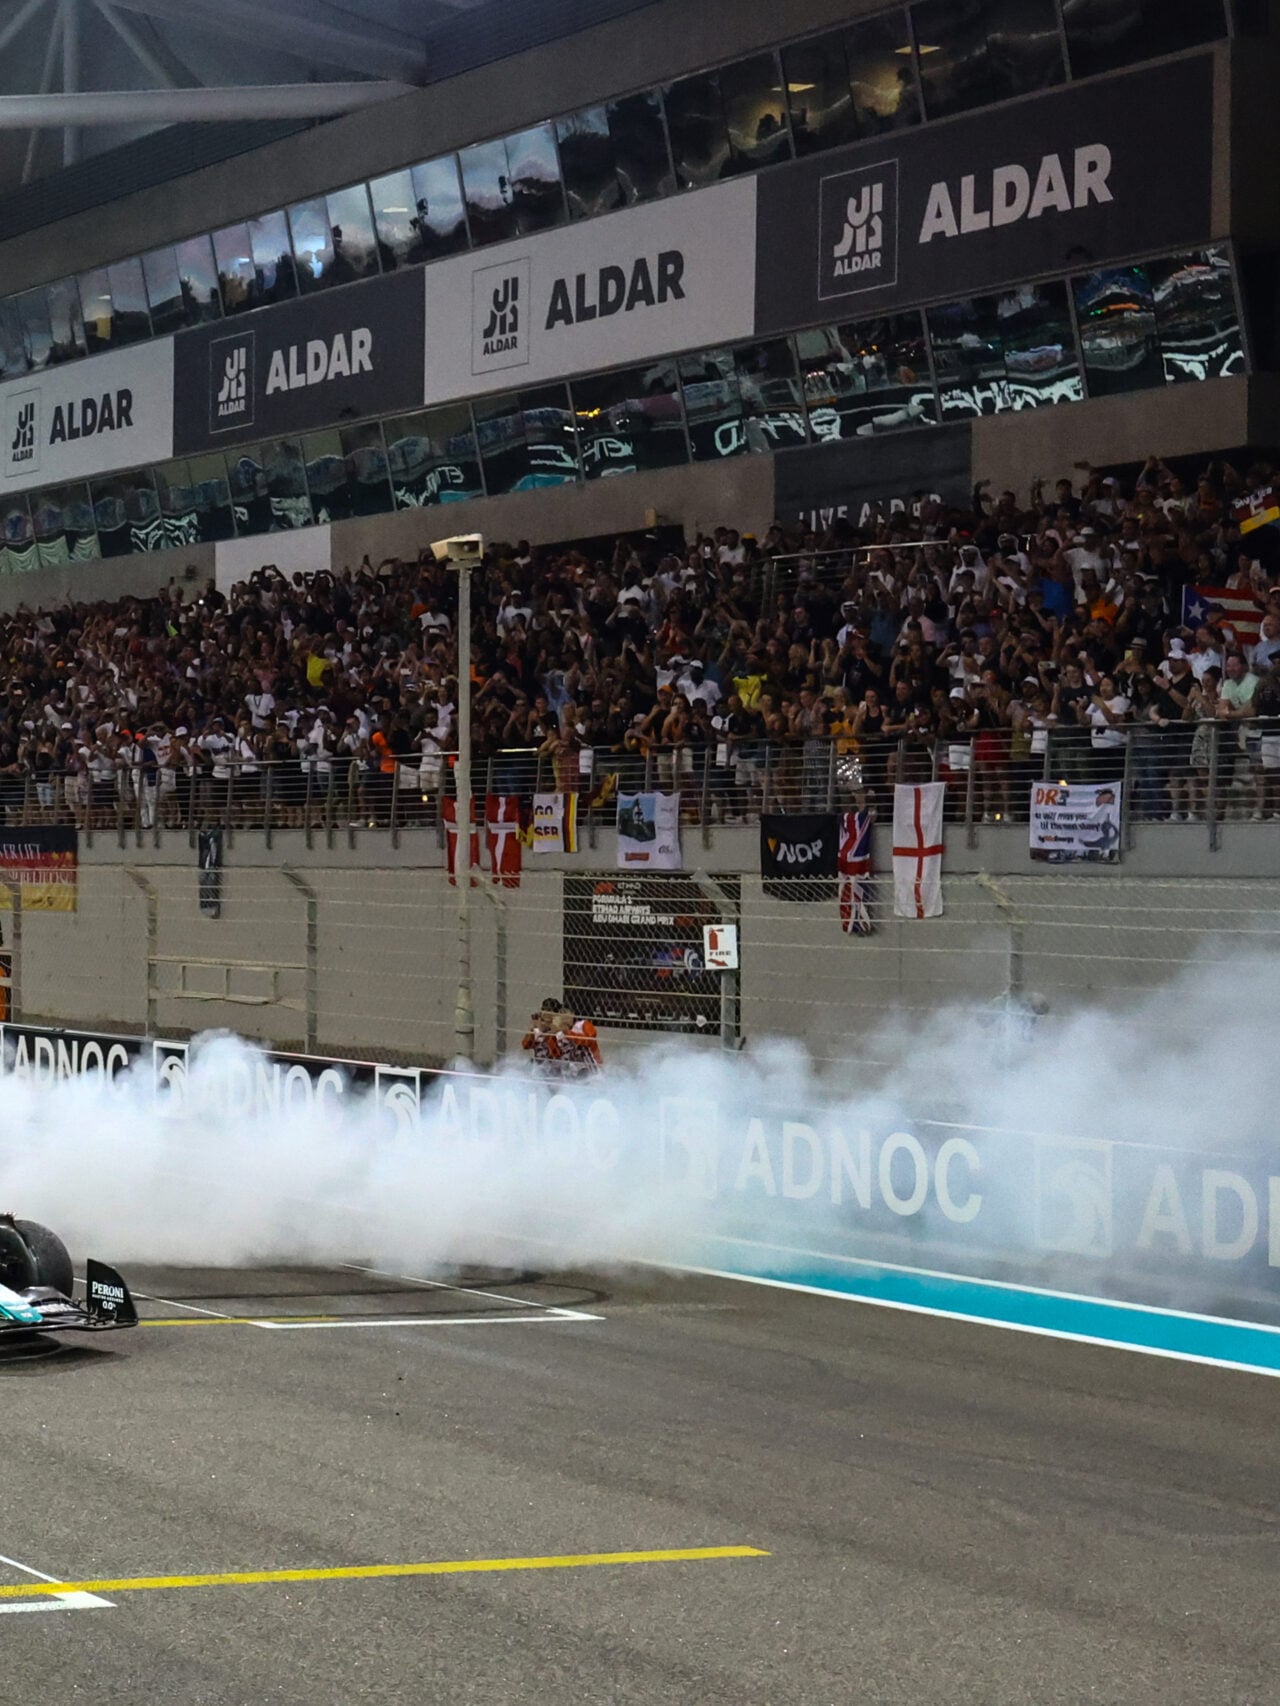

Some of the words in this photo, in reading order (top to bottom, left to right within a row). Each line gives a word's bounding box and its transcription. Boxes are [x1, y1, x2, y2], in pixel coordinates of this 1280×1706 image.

[919, 144, 1113, 243] ALDAR
[834, 252, 881, 276] ALDAR
[545, 250, 685, 330] ALDAR
[266, 328, 373, 395] ALDAR
[483, 336, 517, 355] ALDAR
[49, 389, 133, 445] ALDAR
[218, 399, 245, 416] ALDAR
[535, 805, 553, 819] GO
[733, 1116, 983, 1223] ADNOC
[91, 1280, 125, 1299] PERONI
